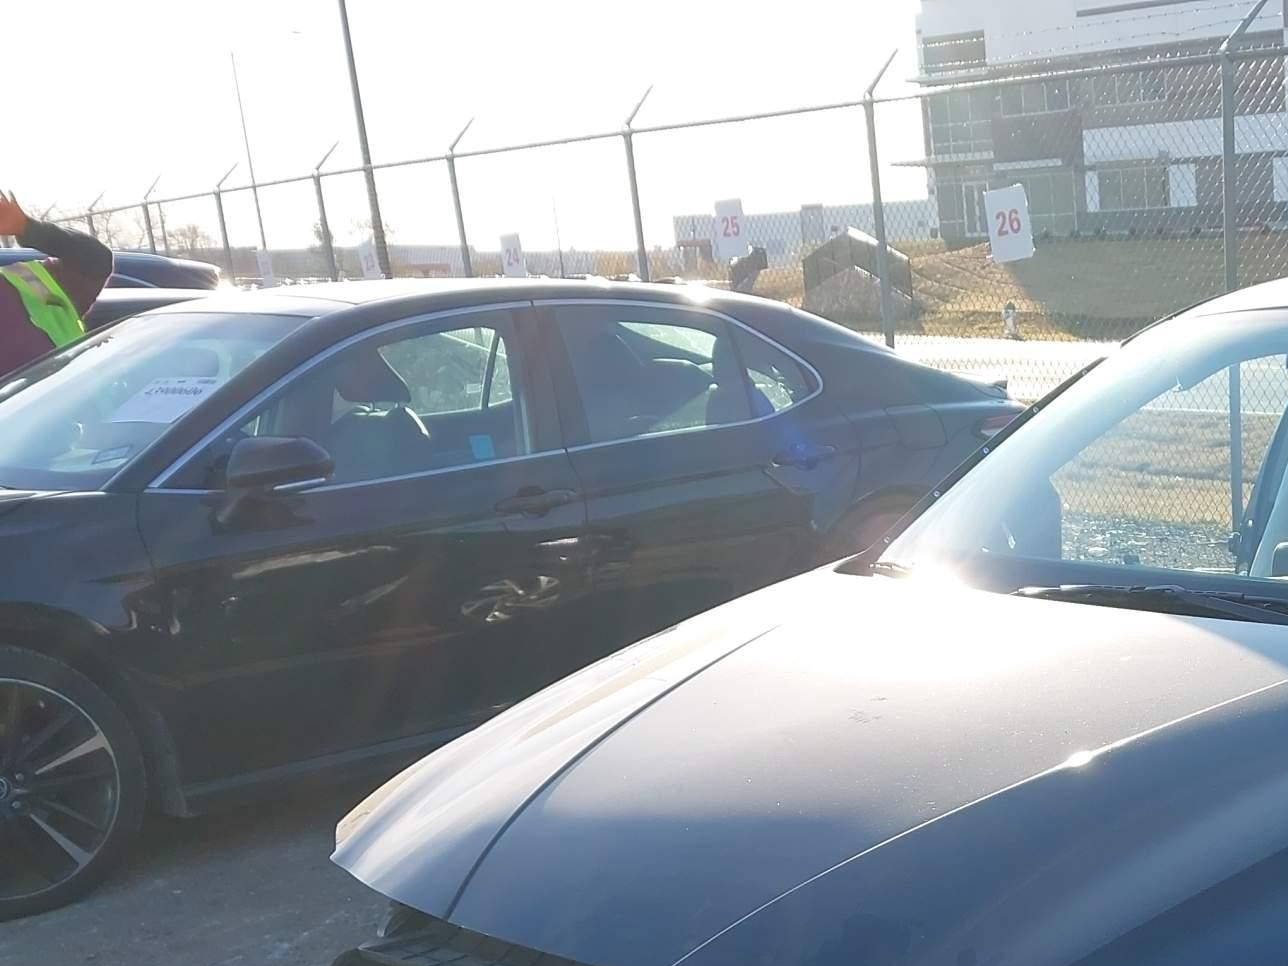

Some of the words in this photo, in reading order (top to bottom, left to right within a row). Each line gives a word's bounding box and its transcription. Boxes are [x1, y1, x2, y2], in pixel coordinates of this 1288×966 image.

[721, 215, 740, 237] 25
[995, 208, 1021, 237] 26
[505, 247, 520, 267] 24
